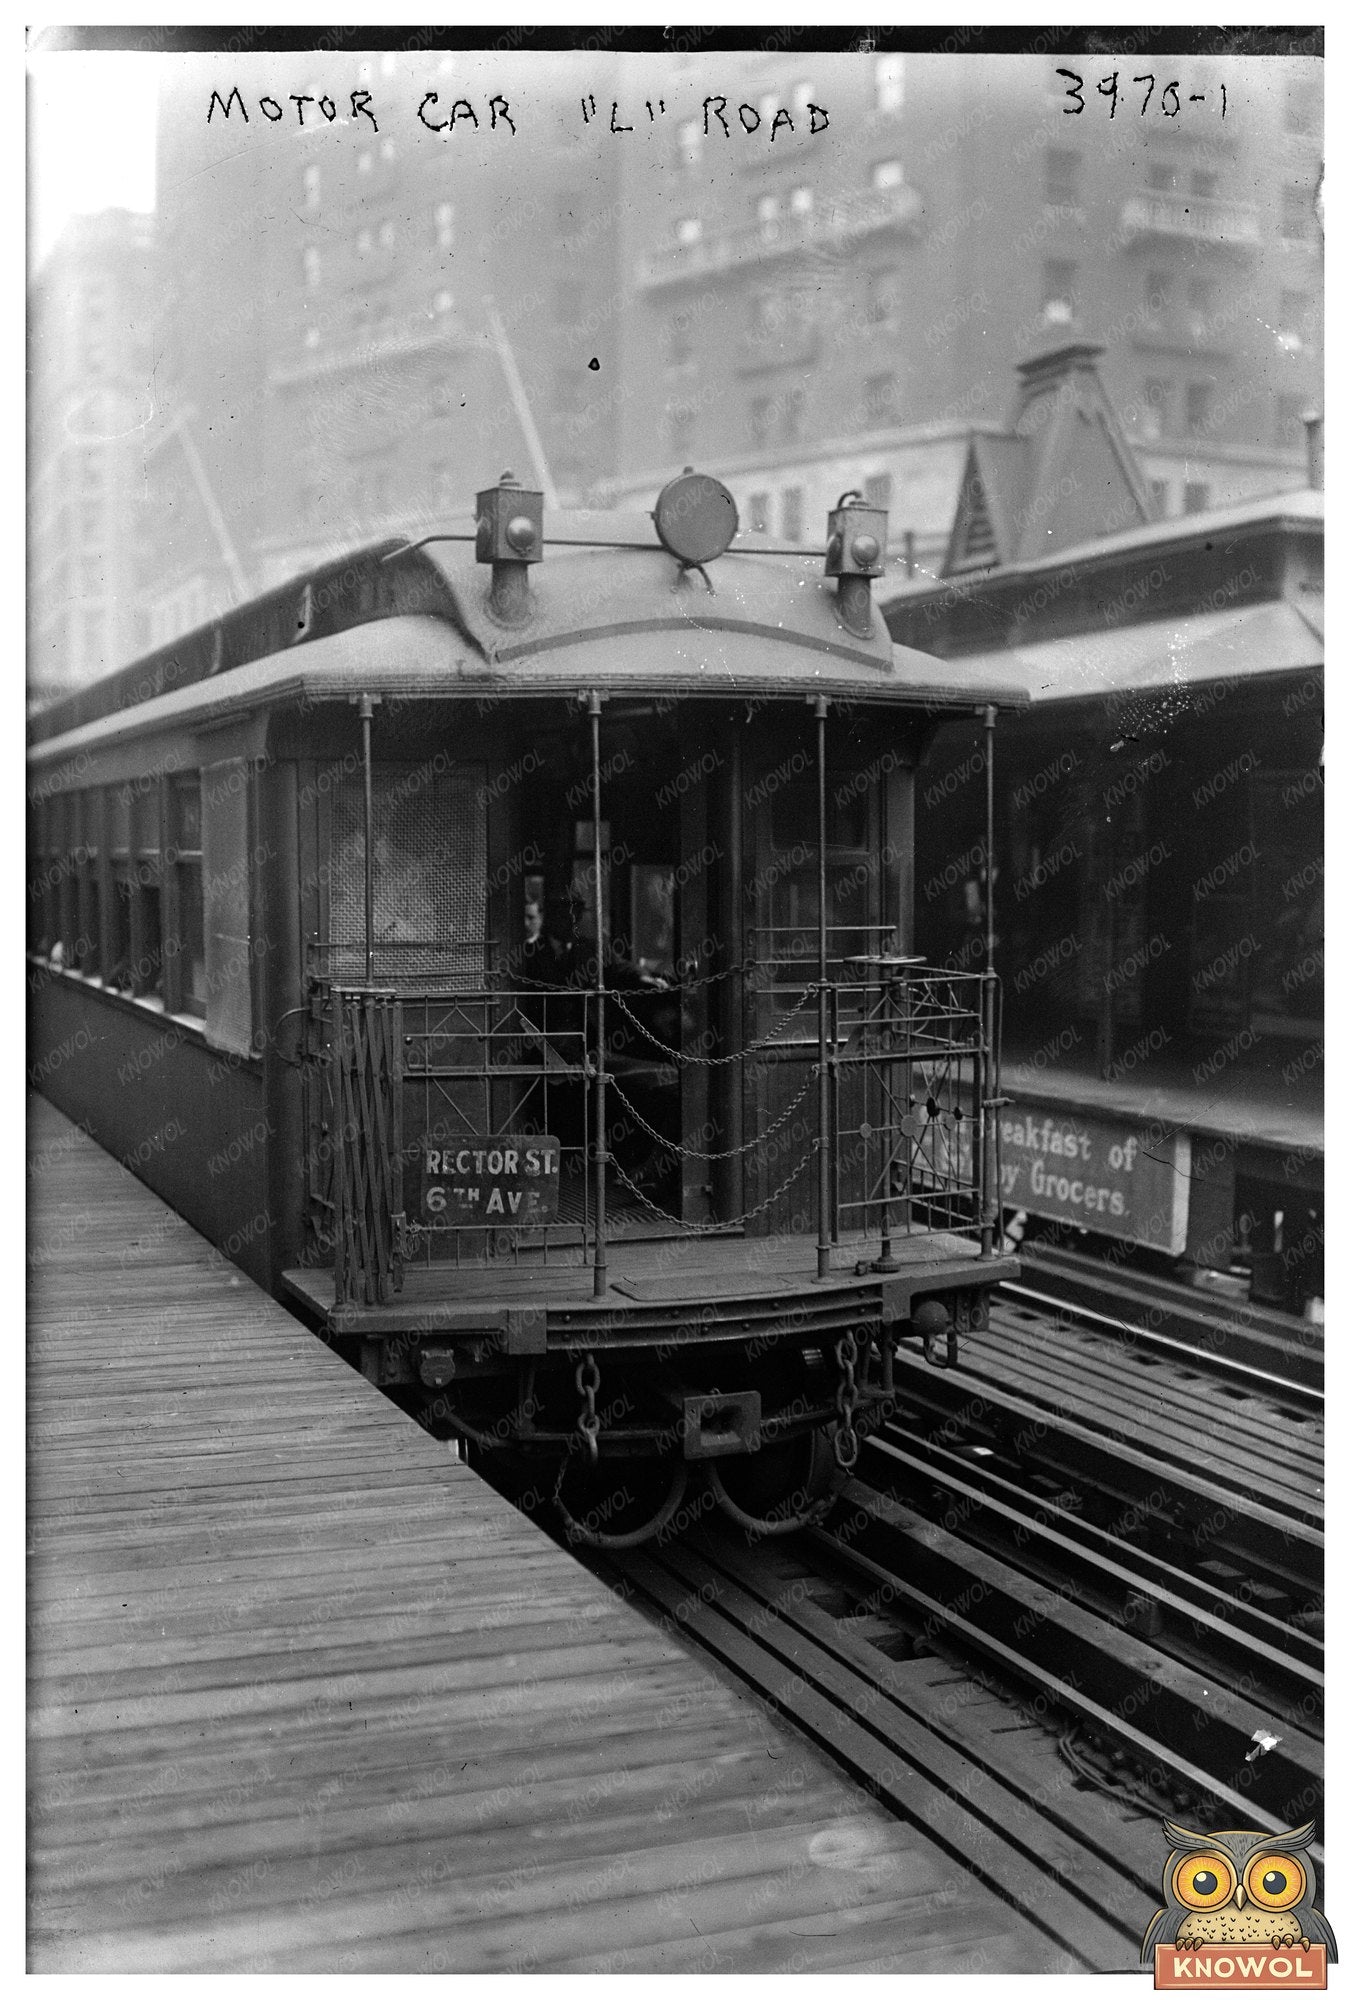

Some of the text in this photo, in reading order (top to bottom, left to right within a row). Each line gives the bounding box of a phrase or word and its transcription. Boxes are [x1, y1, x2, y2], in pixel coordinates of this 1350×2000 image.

[207, 87, 378, 132] MOTOR
[417, 93, 516, 135] CAR
[703, 96, 829, 143] ROAD
[980, 1109, 1092, 1161] reakfast
[1108, 1135, 1139, 1171] of
[426, 1149, 558, 1176] RECTOR ST.
[426, 1187, 548, 1214] 6TH AVE.
